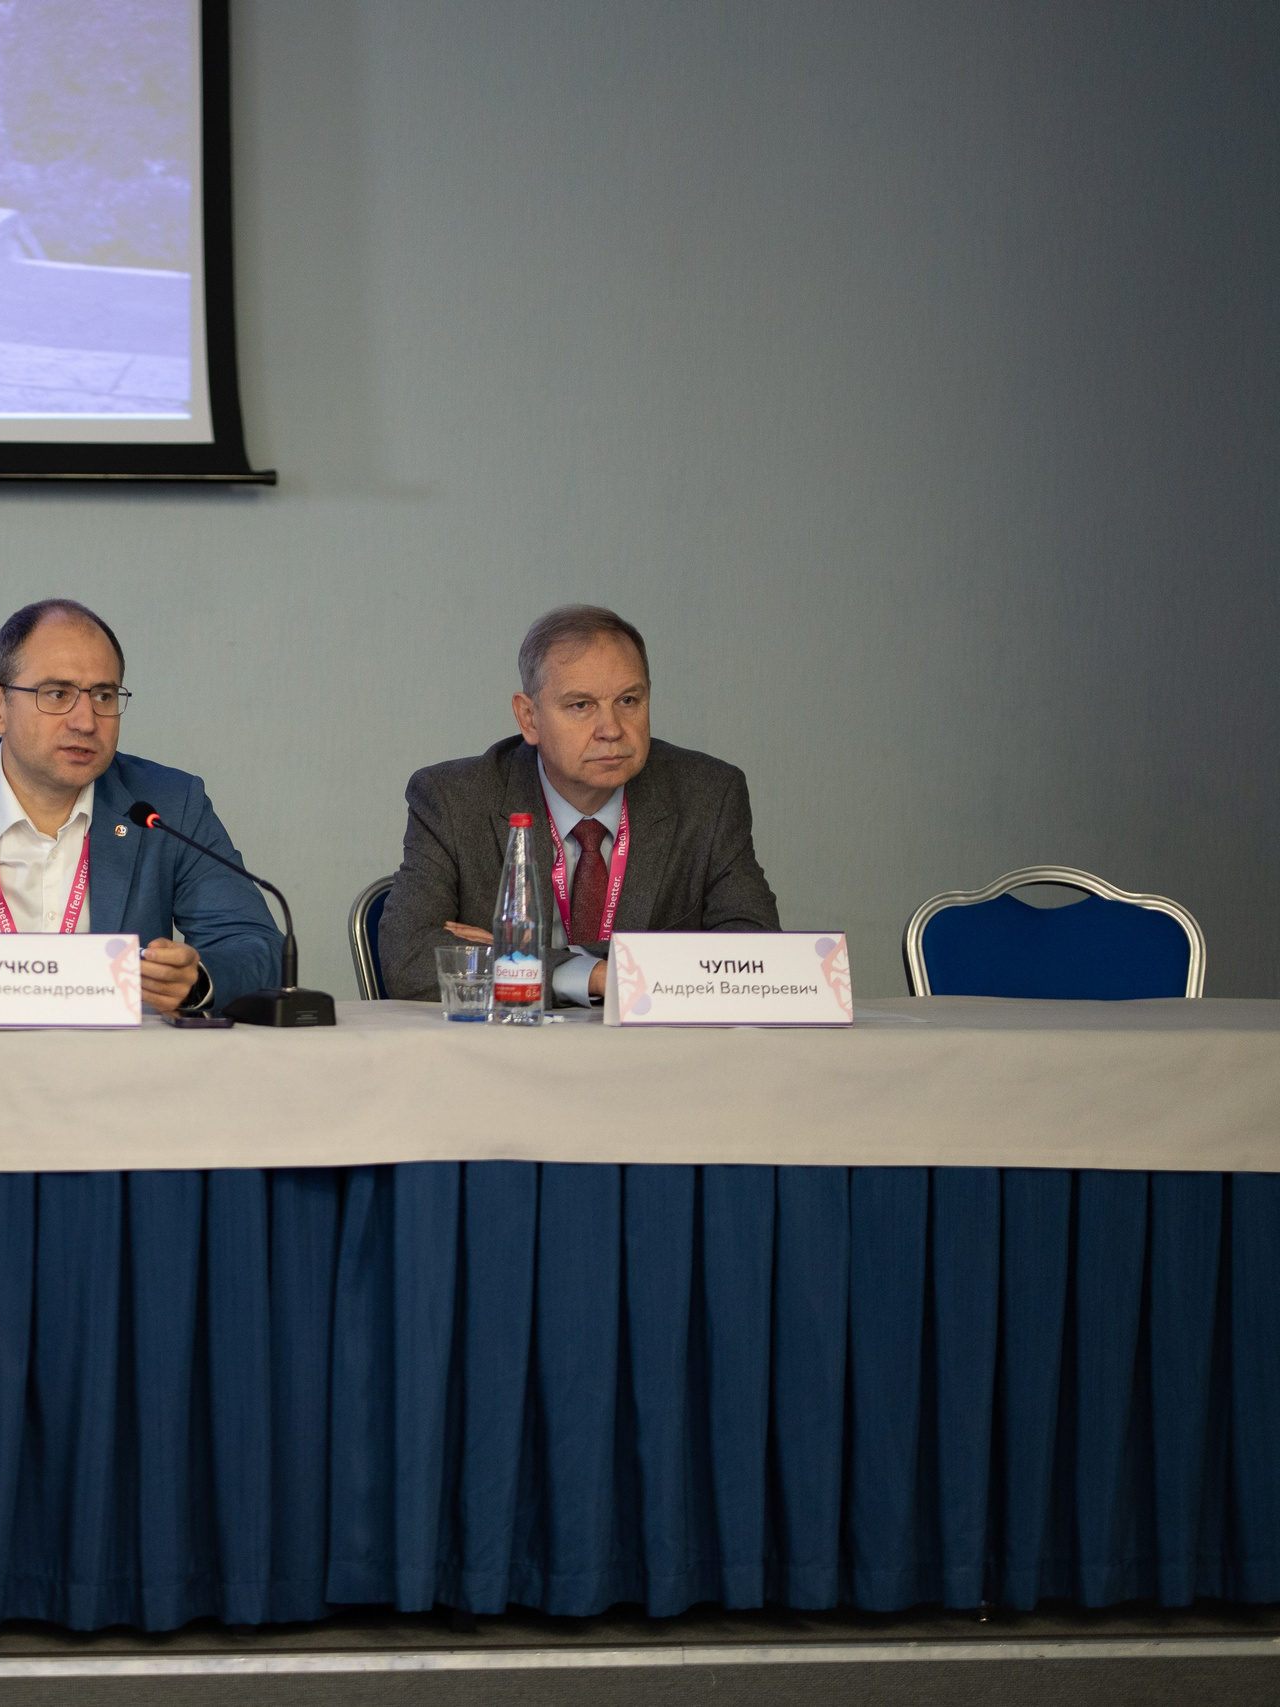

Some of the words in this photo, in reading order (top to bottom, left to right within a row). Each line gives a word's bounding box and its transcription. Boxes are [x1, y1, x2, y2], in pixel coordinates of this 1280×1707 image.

[75, 859, 89, 890] better.
[555, 872, 566, 900] medi.
[608, 875, 622, 908] better.
[70, 890, 82, 910] feel
[65, 917, 75, 934] edi.
[603, 909, 614, 928] feel
[496, 965, 539, 979] Бештау
[699, 959, 764, 974] ЧУПИН
[652, 980, 715, 999] Андрей
[720, 982, 818, 998] Валерьевич
